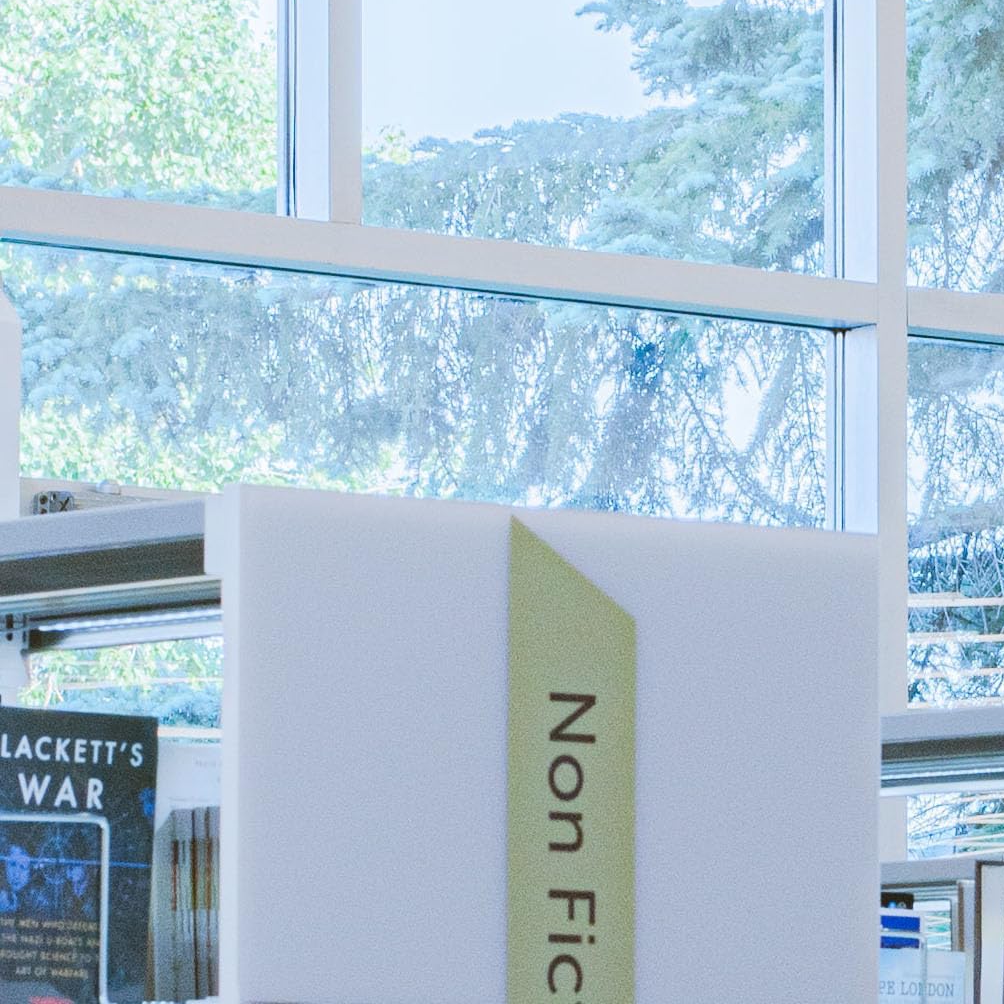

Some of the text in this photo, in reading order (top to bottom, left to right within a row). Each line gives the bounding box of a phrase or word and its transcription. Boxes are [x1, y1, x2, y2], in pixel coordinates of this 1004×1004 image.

[17, 772, 105, 811] WAR
[548, 691, 597, 853] Non
[900, 980, 955, 997] LONDON
